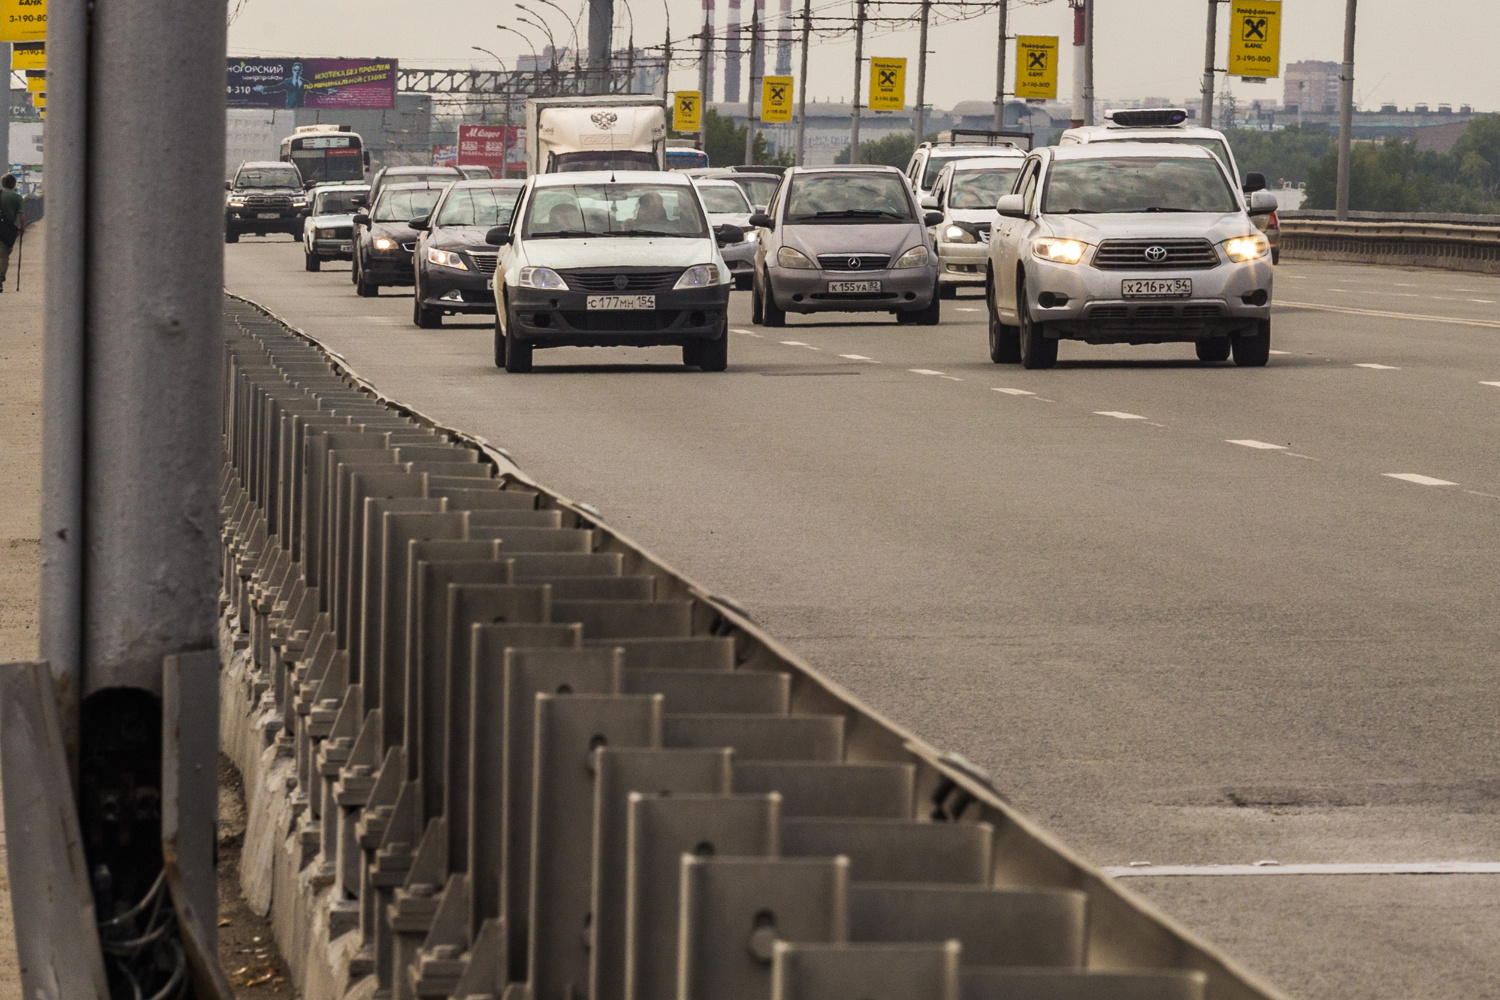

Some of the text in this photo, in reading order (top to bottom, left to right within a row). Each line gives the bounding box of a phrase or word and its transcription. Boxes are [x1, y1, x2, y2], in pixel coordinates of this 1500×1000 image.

[1236, 55, 1272, 63] 3-190-800
[831, 281, 879, 292] К155УА 82
[1127, 280, 1187, 293] Х216РХ 54
[590, 296, 654, 309] С177МН 154
